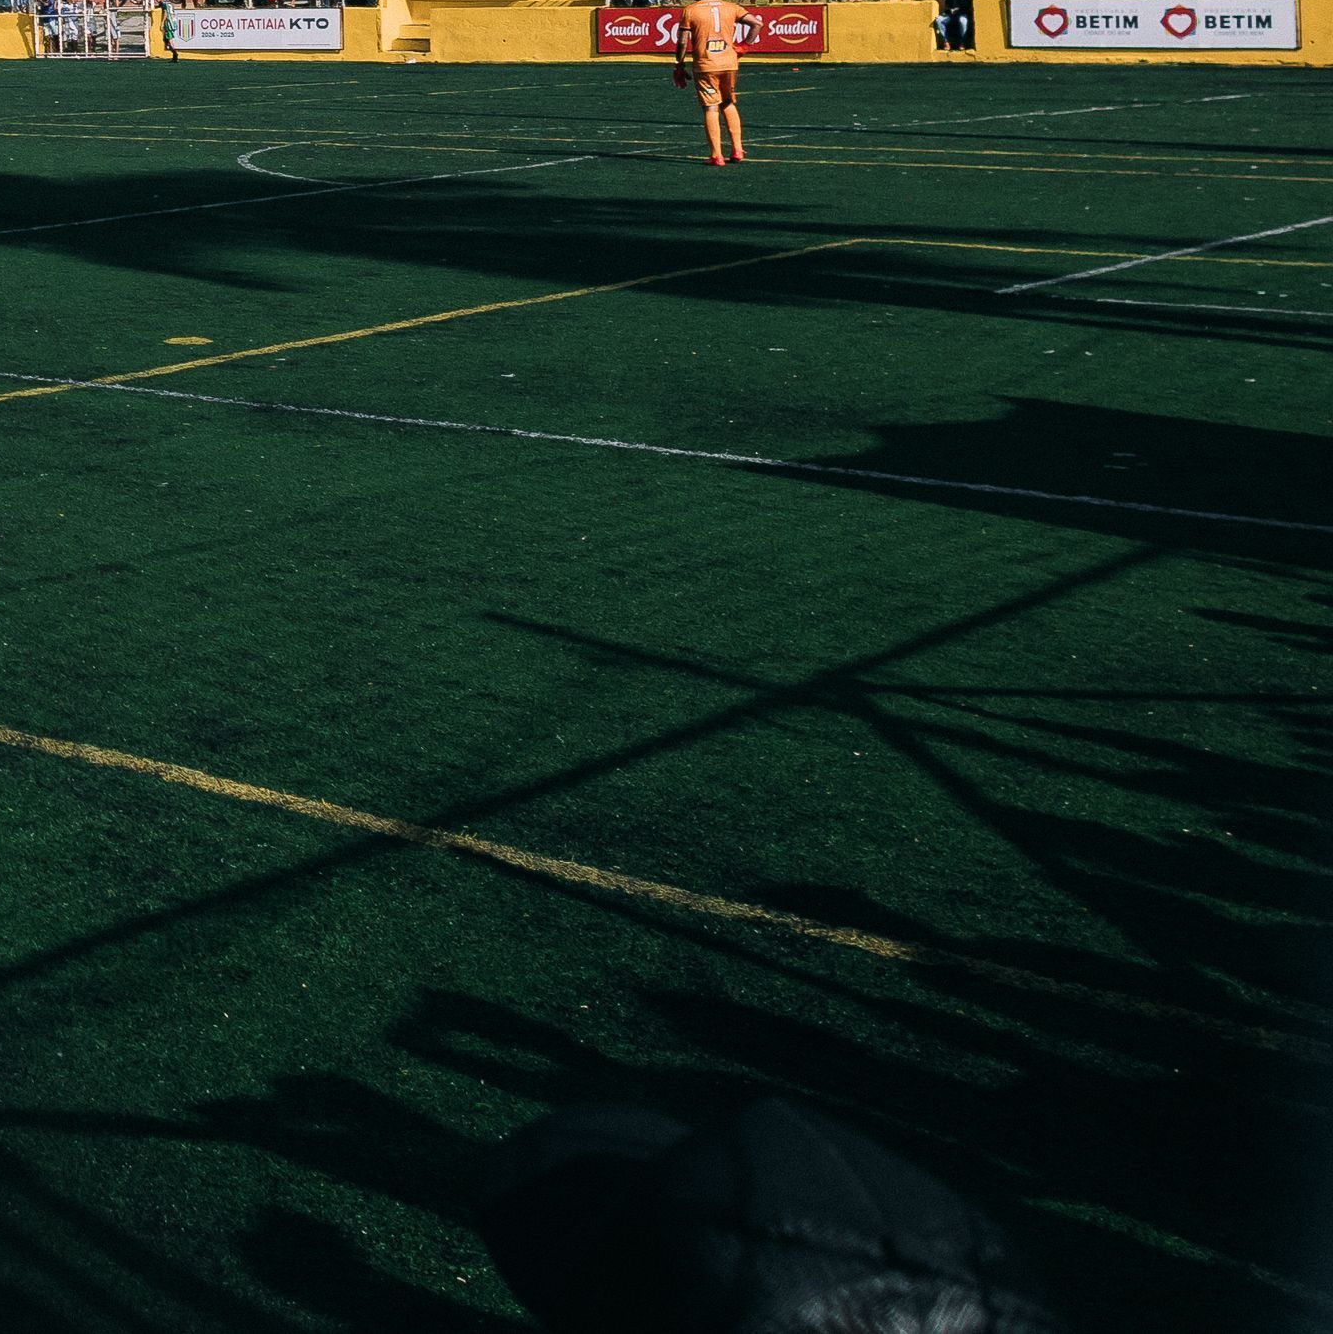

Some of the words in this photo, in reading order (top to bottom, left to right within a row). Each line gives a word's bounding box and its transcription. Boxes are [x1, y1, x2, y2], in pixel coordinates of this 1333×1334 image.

[200, 18, 234, 30] COPA
[237, 18, 286, 30] ITATIAIA
[289, 17, 330, 30] KTO
[710, 6, 721, 33] 1
[1076, 15, 1139, 29] BETIM
[1204, 15, 1272, 29] BETIM
[604, 21, 650, 37] Saudali
[768, 19, 818, 36] Saudali
